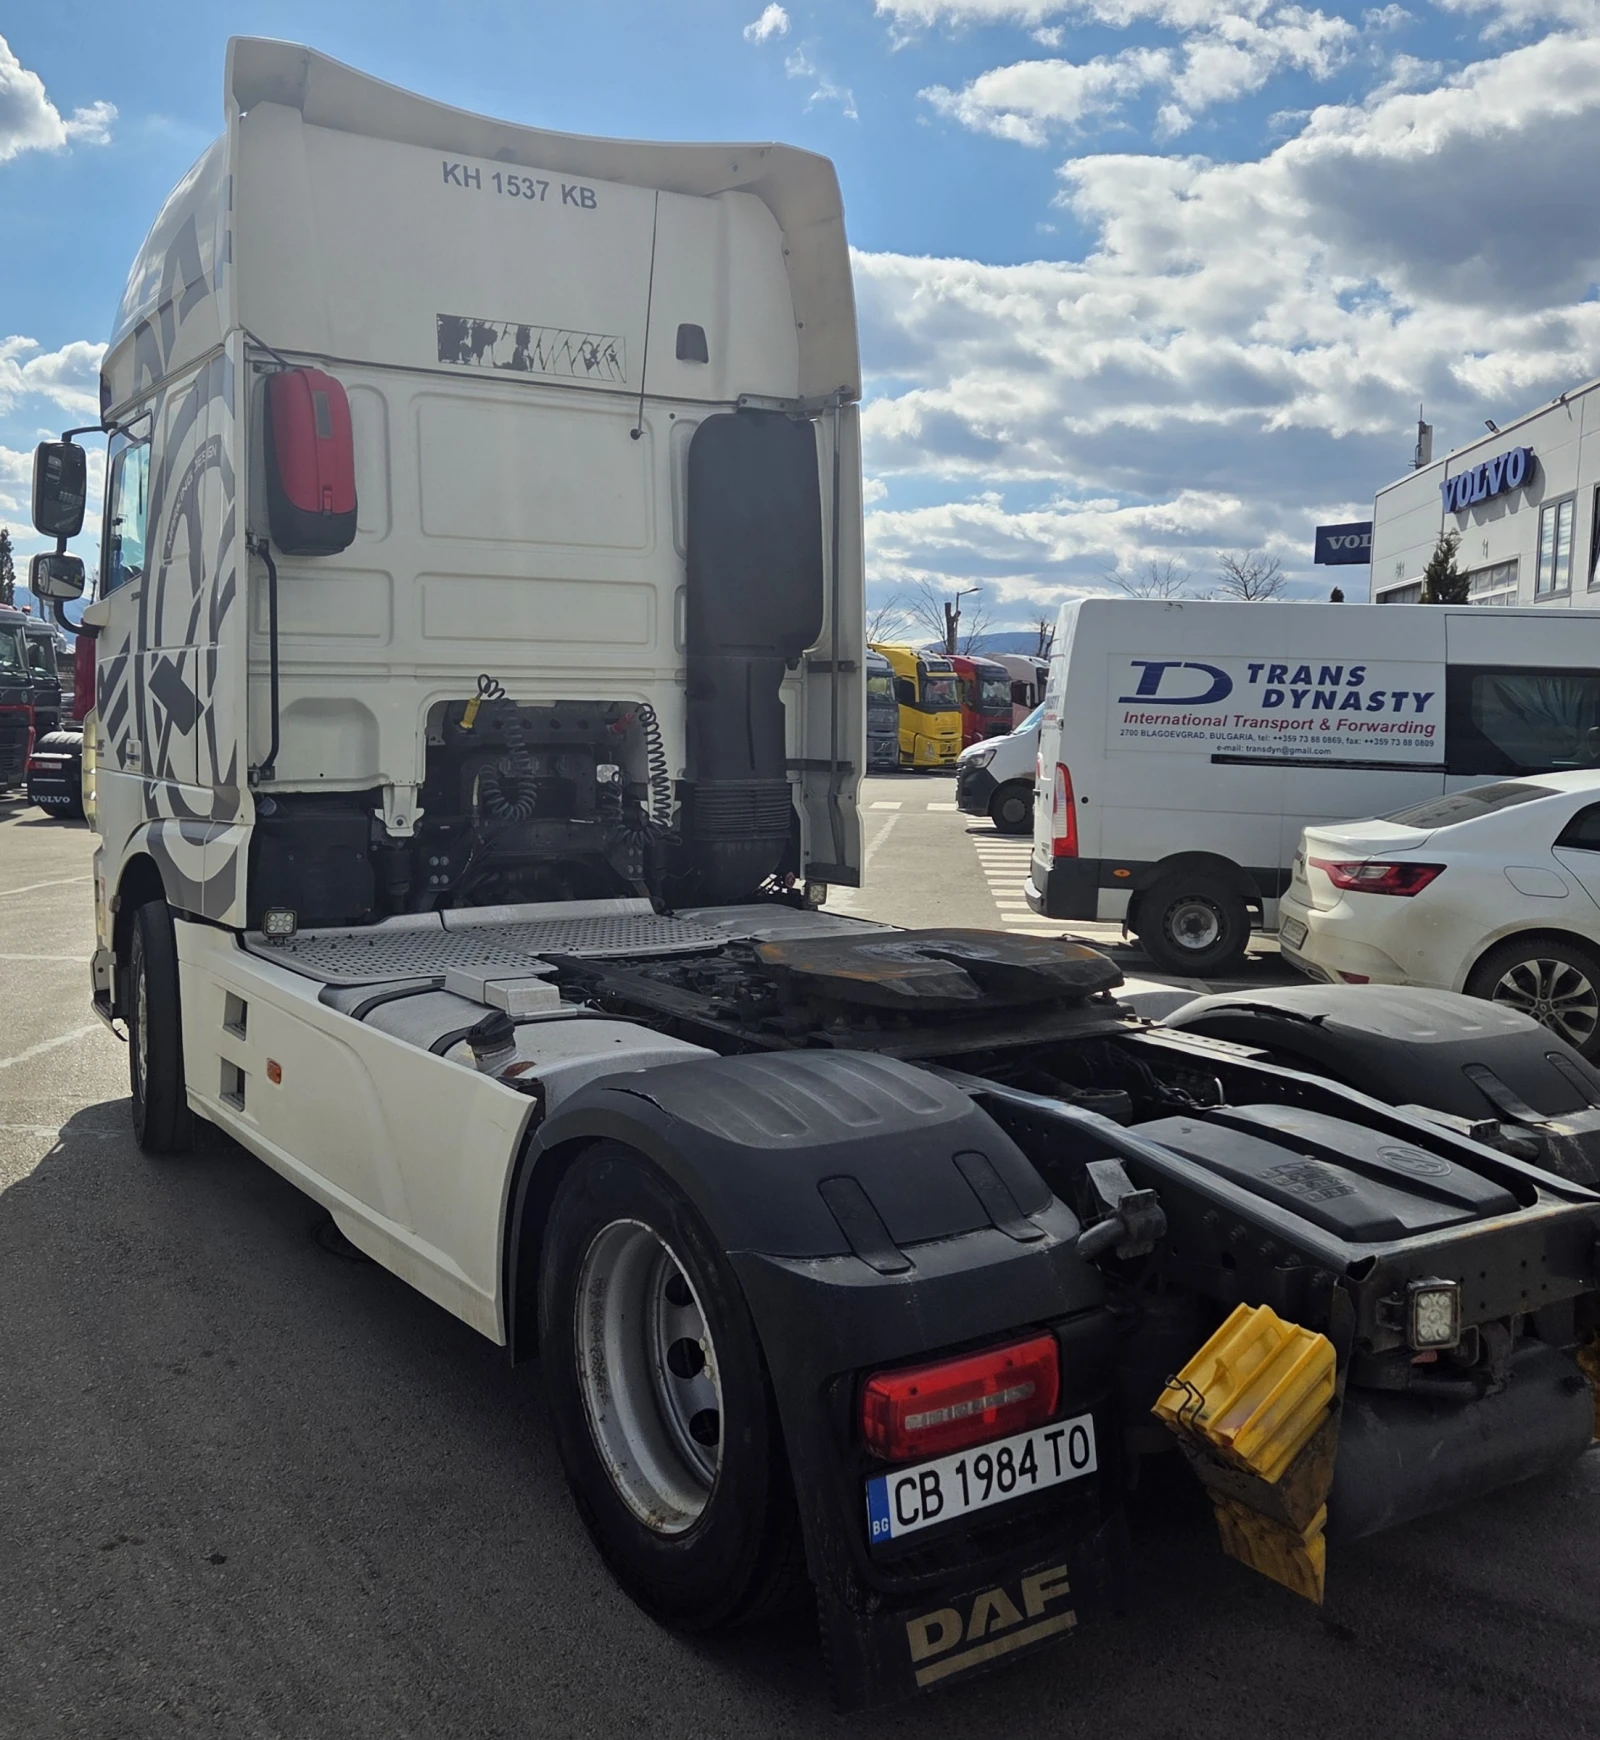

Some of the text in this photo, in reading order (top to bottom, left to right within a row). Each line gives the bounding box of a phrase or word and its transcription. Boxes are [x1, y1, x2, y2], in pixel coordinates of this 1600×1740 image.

[442, 161, 598, 210] KH 1537 KB
[1439, 446, 1531, 514] VOLVO
[1247, 663, 1367, 687] TRANS
[1261, 689, 1435, 713] DYNASTY
[1123, 711, 1436, 738] International Transport & Forwarding
[1120, 729, 1139, 737] 2700
[1140, 729, 1208, 740] BLAGOEVGRAD,
[1209, 733, 1256, 742] BULGARIA,
[1299, 735, 1309, 743] 73
[1311, 736, 1321, 744] 88
[1346, 737, 1362, 745] fax:
[1391, 738, 1401, 746] 73
[1403, 739, 1413, 747] 88
[1217, 744, 1332, 756] e-mail: transdyn@gmail.com
[31, 795, 71, 804] VOLVO
[894, 1424, 1091, 1527] CB 1984 TO
[872, 1517, 890, 1537] BG
[906, 1564, 1071, 1662] DAF
